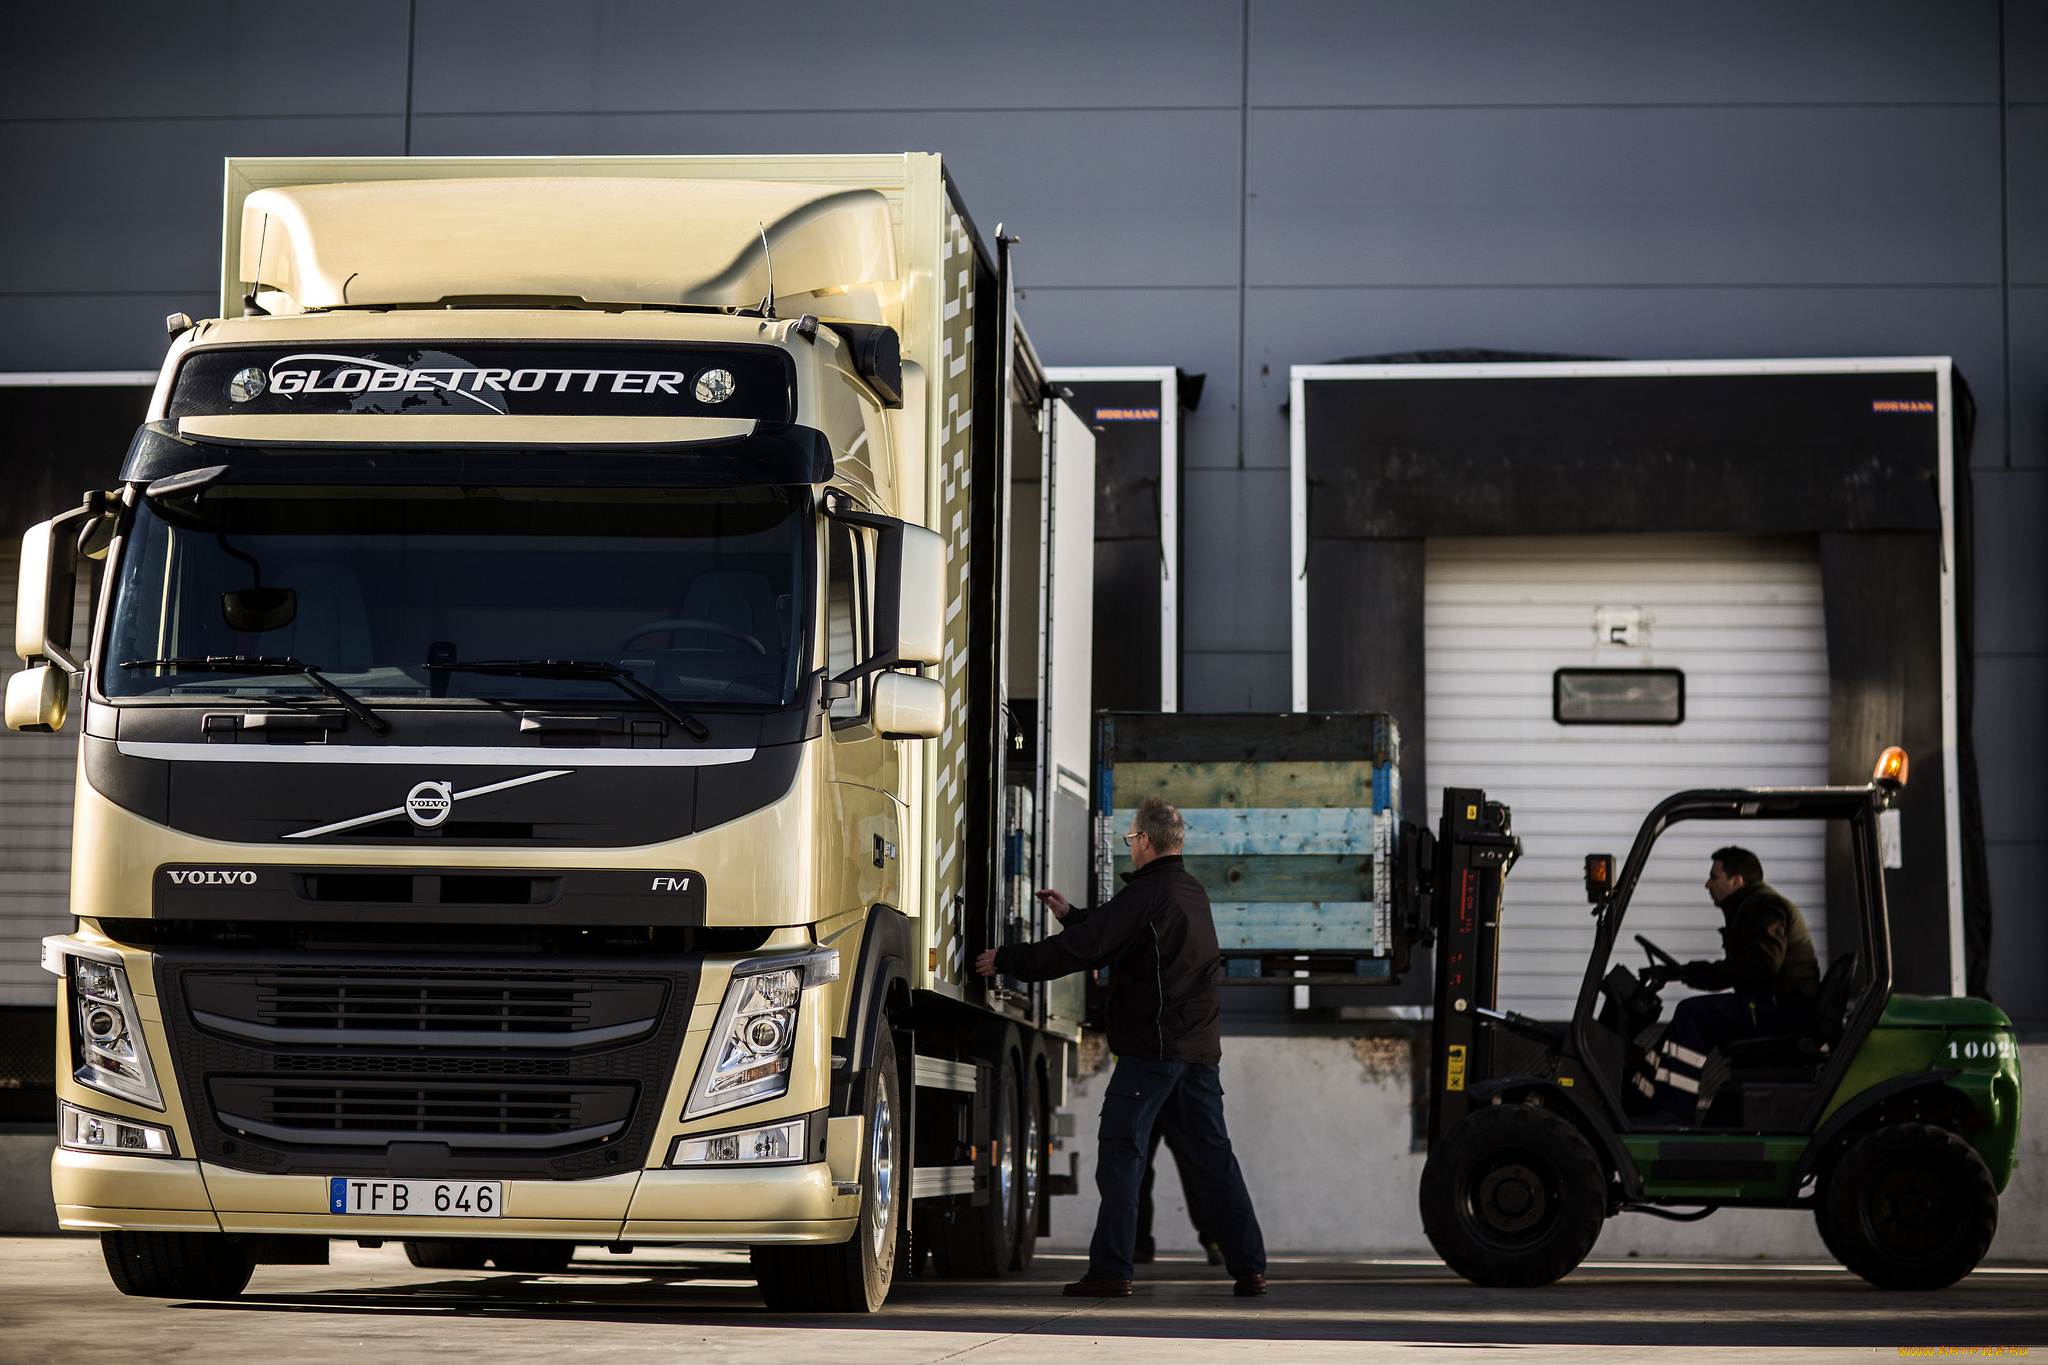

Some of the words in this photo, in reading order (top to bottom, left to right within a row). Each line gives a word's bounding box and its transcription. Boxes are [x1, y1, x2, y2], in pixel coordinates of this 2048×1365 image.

[268, 367, 685, 395] GLOBETROTTER
[166, 870, 258, 885] VOLVO
[651, 877, 690, 891] FM
[1948, 1041, 2017, 1059] 10021
[335, 1199, 342, 1208] S
[351, 1182, 409, 1211] TFB
[434, 1184, 493, 1213] 646
